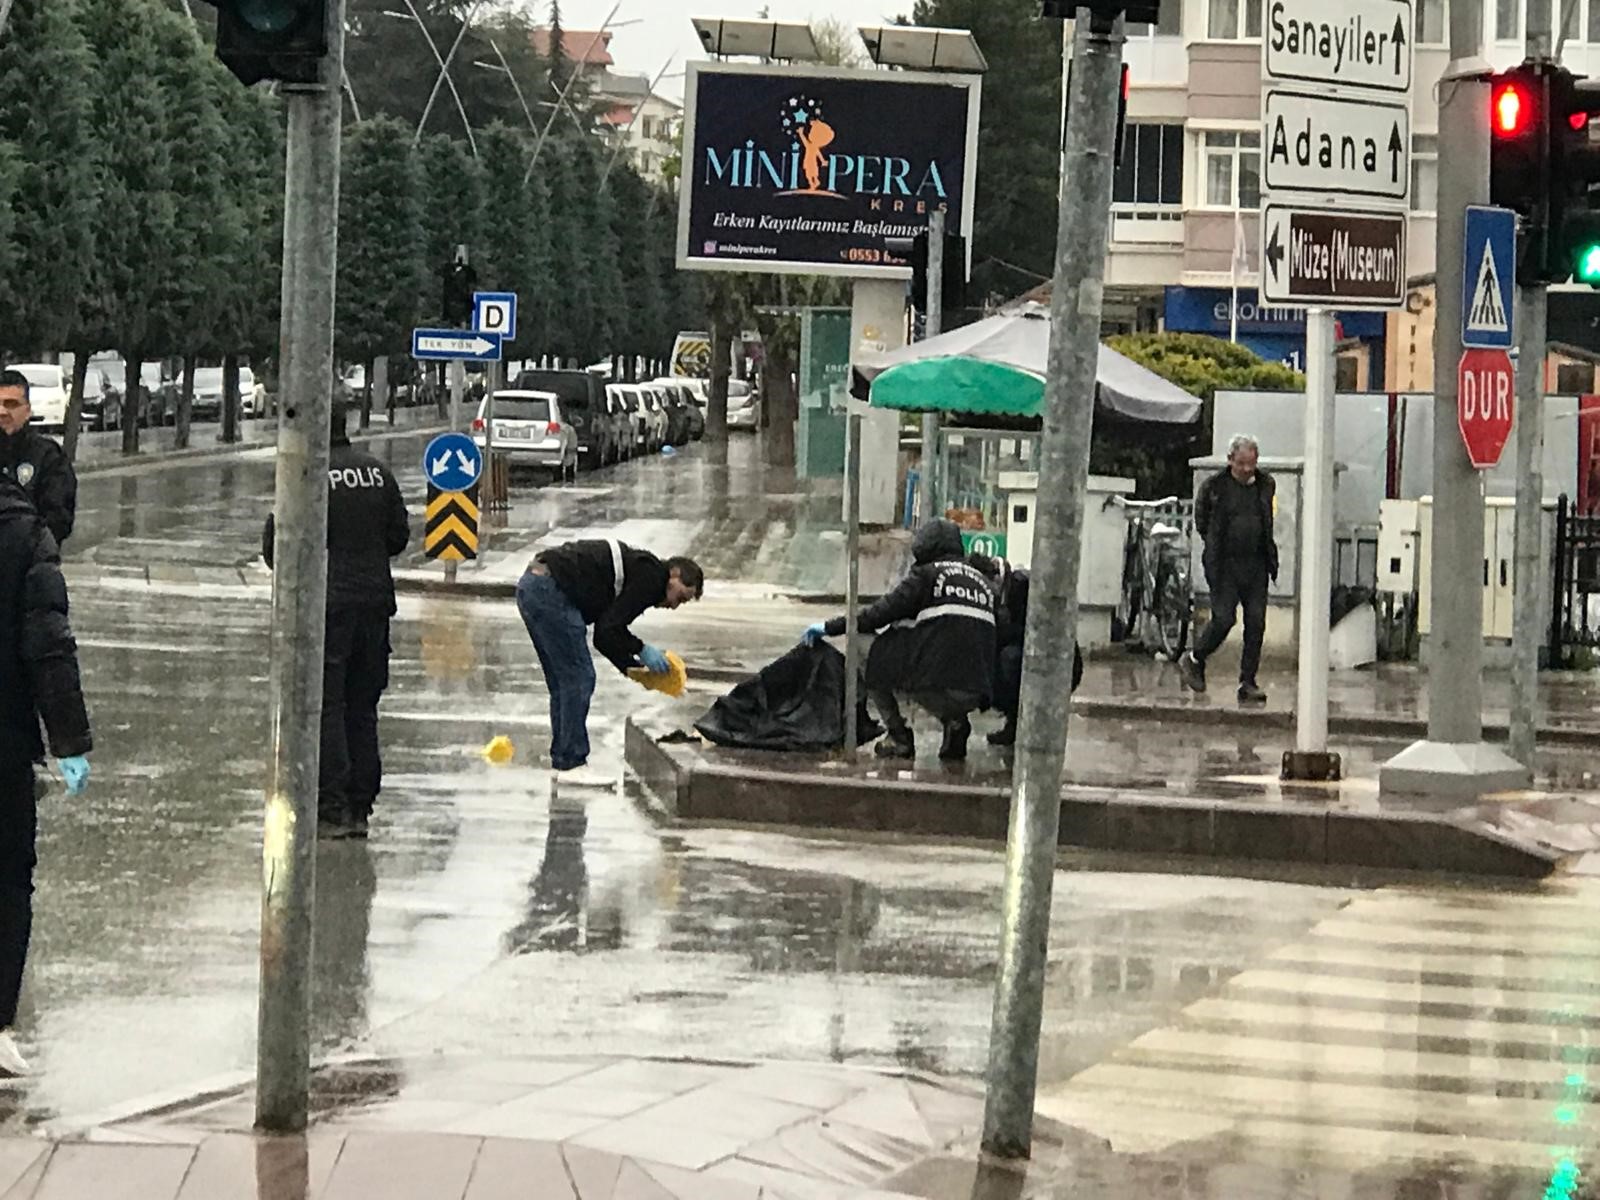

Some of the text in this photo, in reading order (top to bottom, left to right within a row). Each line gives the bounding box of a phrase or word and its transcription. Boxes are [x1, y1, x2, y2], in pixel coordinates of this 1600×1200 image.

[1271, 2, 1387, 73] Sanayiler
[1270, 114, 1376, 172] Adana
[827, 153, 948, 198] PERA
[713, 212, 755, 229] Erken
[1291, 227, 1400, 295] Müze (Museum)
[486, 305, 504, 329] D
[1463, 370, 1510, 422] DUR
